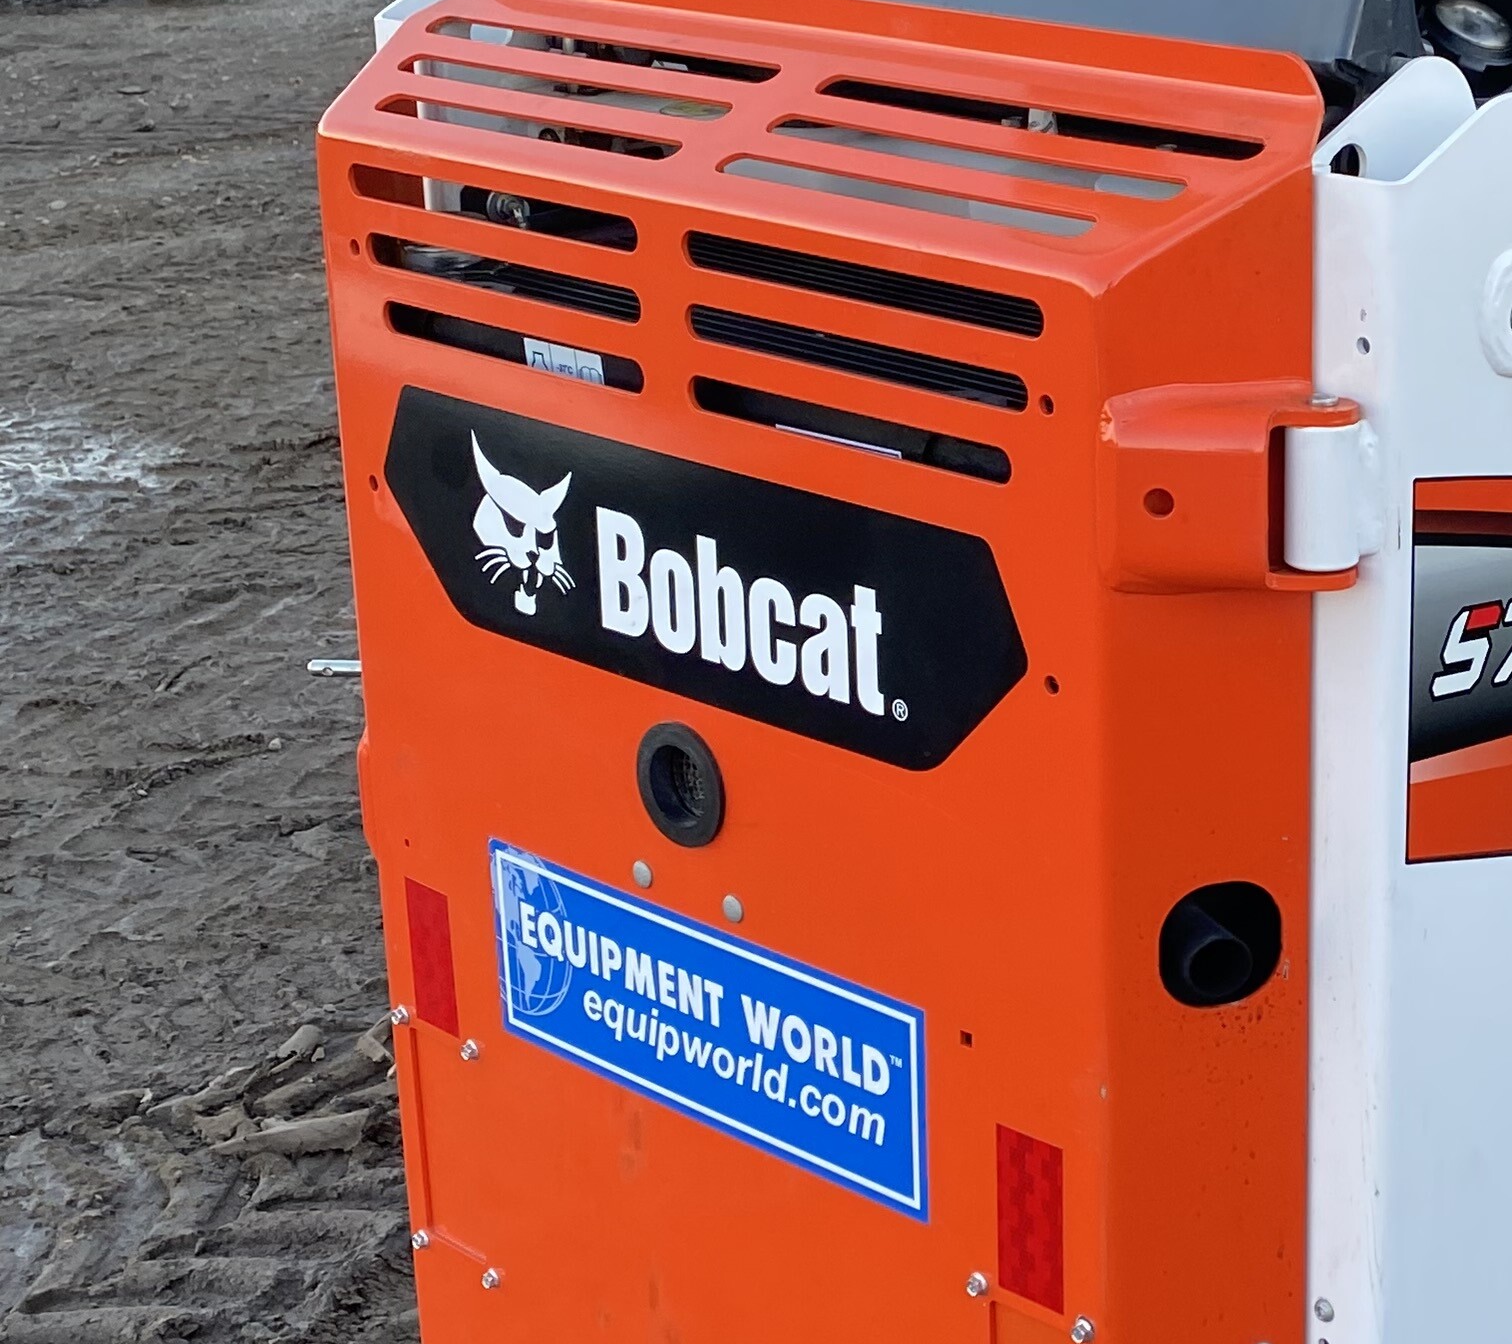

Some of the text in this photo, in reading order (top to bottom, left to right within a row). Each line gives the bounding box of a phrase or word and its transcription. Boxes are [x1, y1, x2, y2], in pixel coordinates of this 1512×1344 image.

[595, 506, 885, 716] Bobcat
[518, 901, 724, 1028] EQUIPMENT
[740, 994, 890, 1096] WORLD
[582, 989, 886, 1146] equipworld.com
